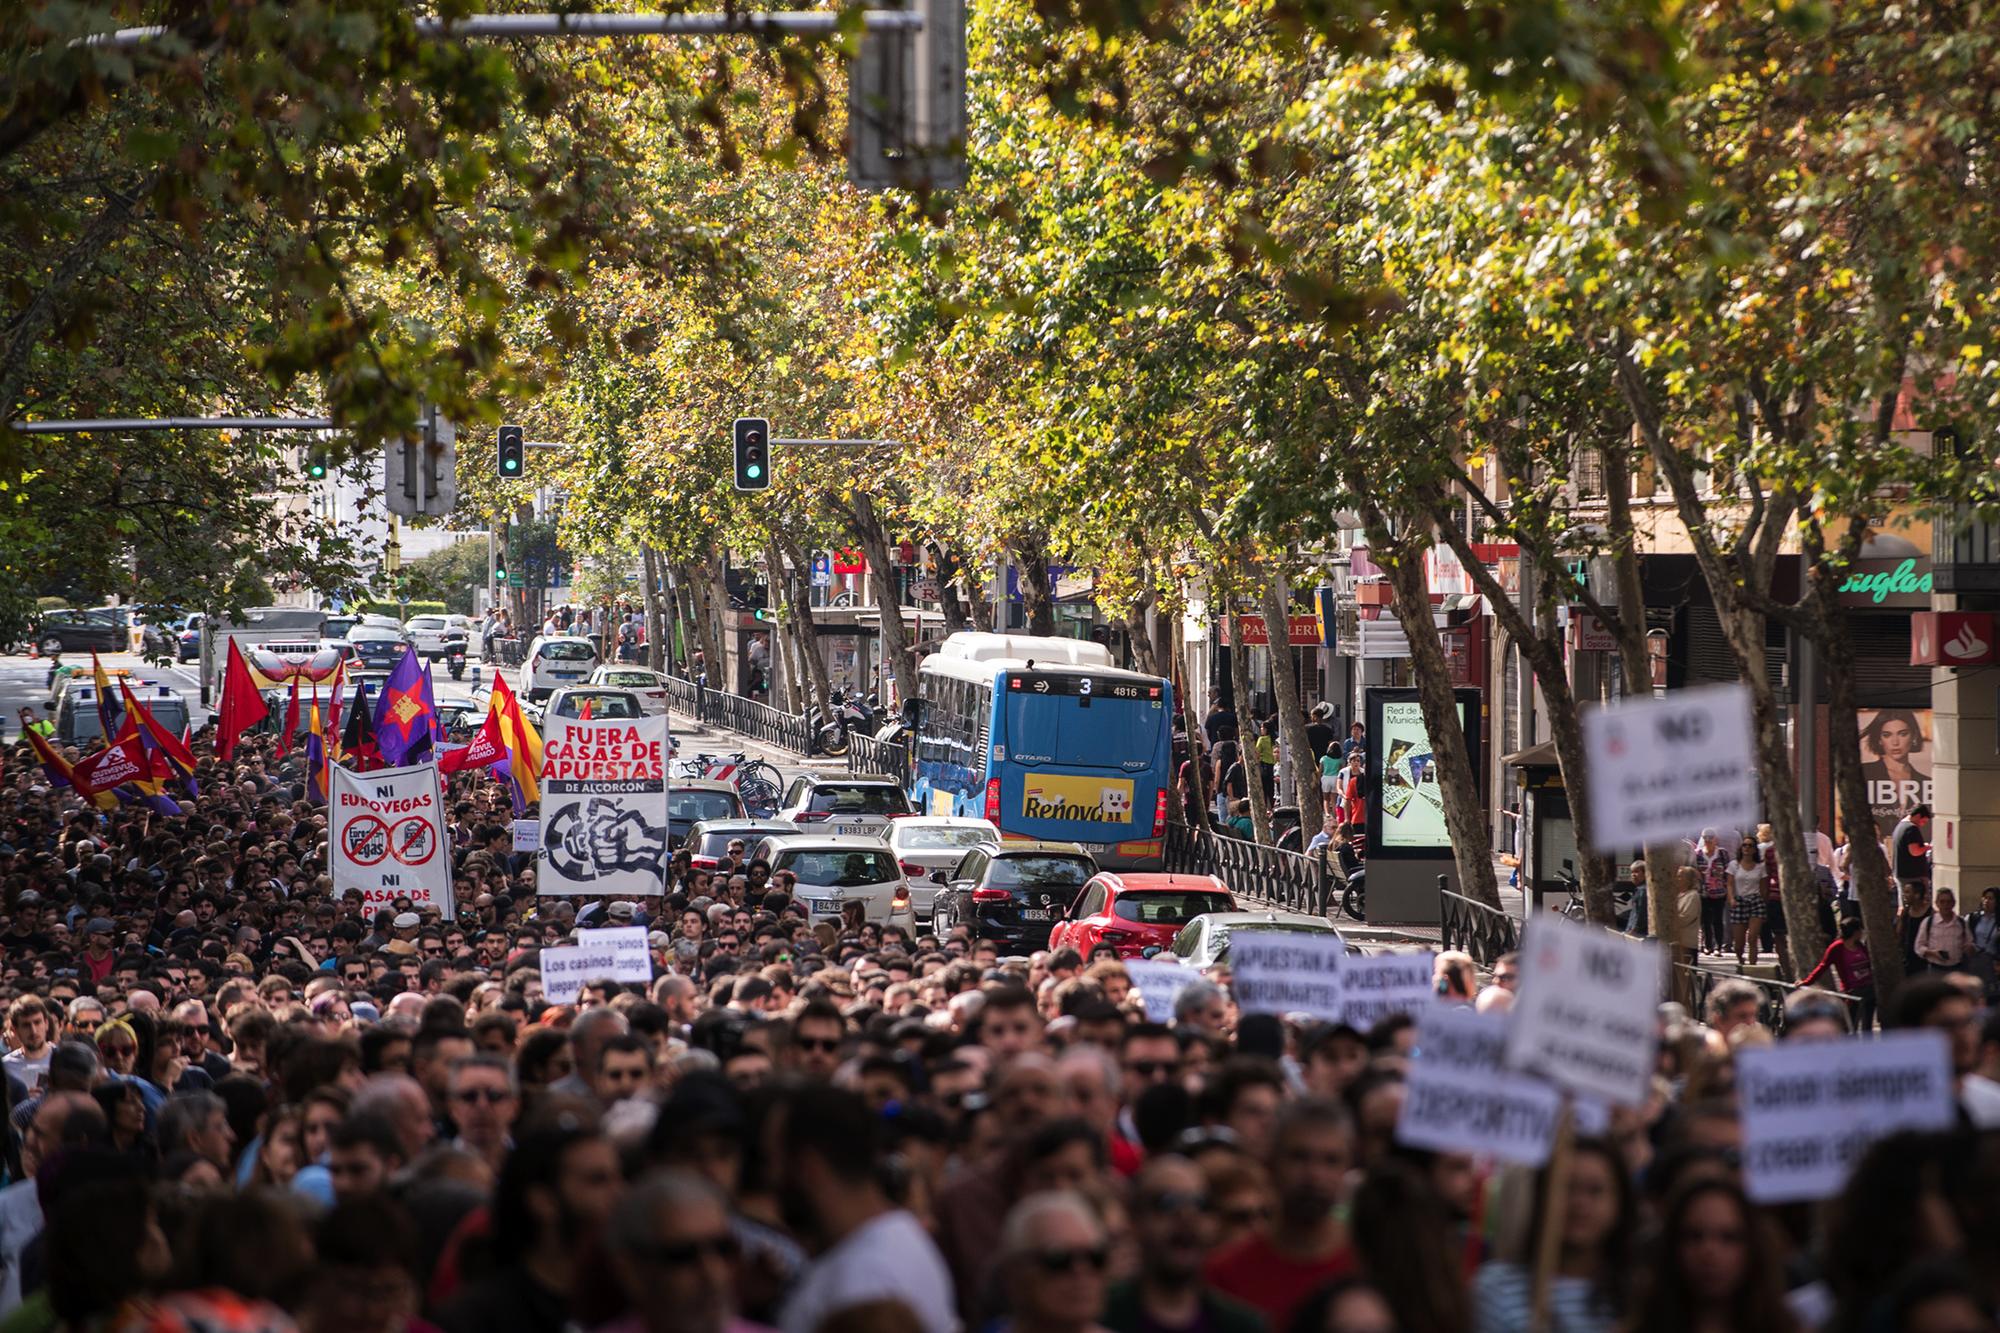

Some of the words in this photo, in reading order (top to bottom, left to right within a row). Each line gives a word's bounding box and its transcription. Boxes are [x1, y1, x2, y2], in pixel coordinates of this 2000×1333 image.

[1080, 678, 1092, 694] 3
[1113, 687, 1137, 697] 4816
[1387, 706, 1404, 714] Red
[1407, 706, 1417, 714] de
[566, 725, 640, 746] FUERA
[544, 740, 623, 761] CASAS
[631, 741, 660, 761] DE
[541, 760, 664, 780] APUESTAS
[376, 785, 394, 798] NI
[565, 783, 579, 792] DE
[1867, 780, 1933, 805] IBRE
[341, 793, 432, 814] EUROVEGAS
[382, 874, 400, 886] NI
[363, 889, 405, 902] ASAS
[411, 889, 431, 901] DE
[818, 902, 840, 910] 8476
[545, 958, 565, 972] Los
[569, 954, 614, 971] casinos
